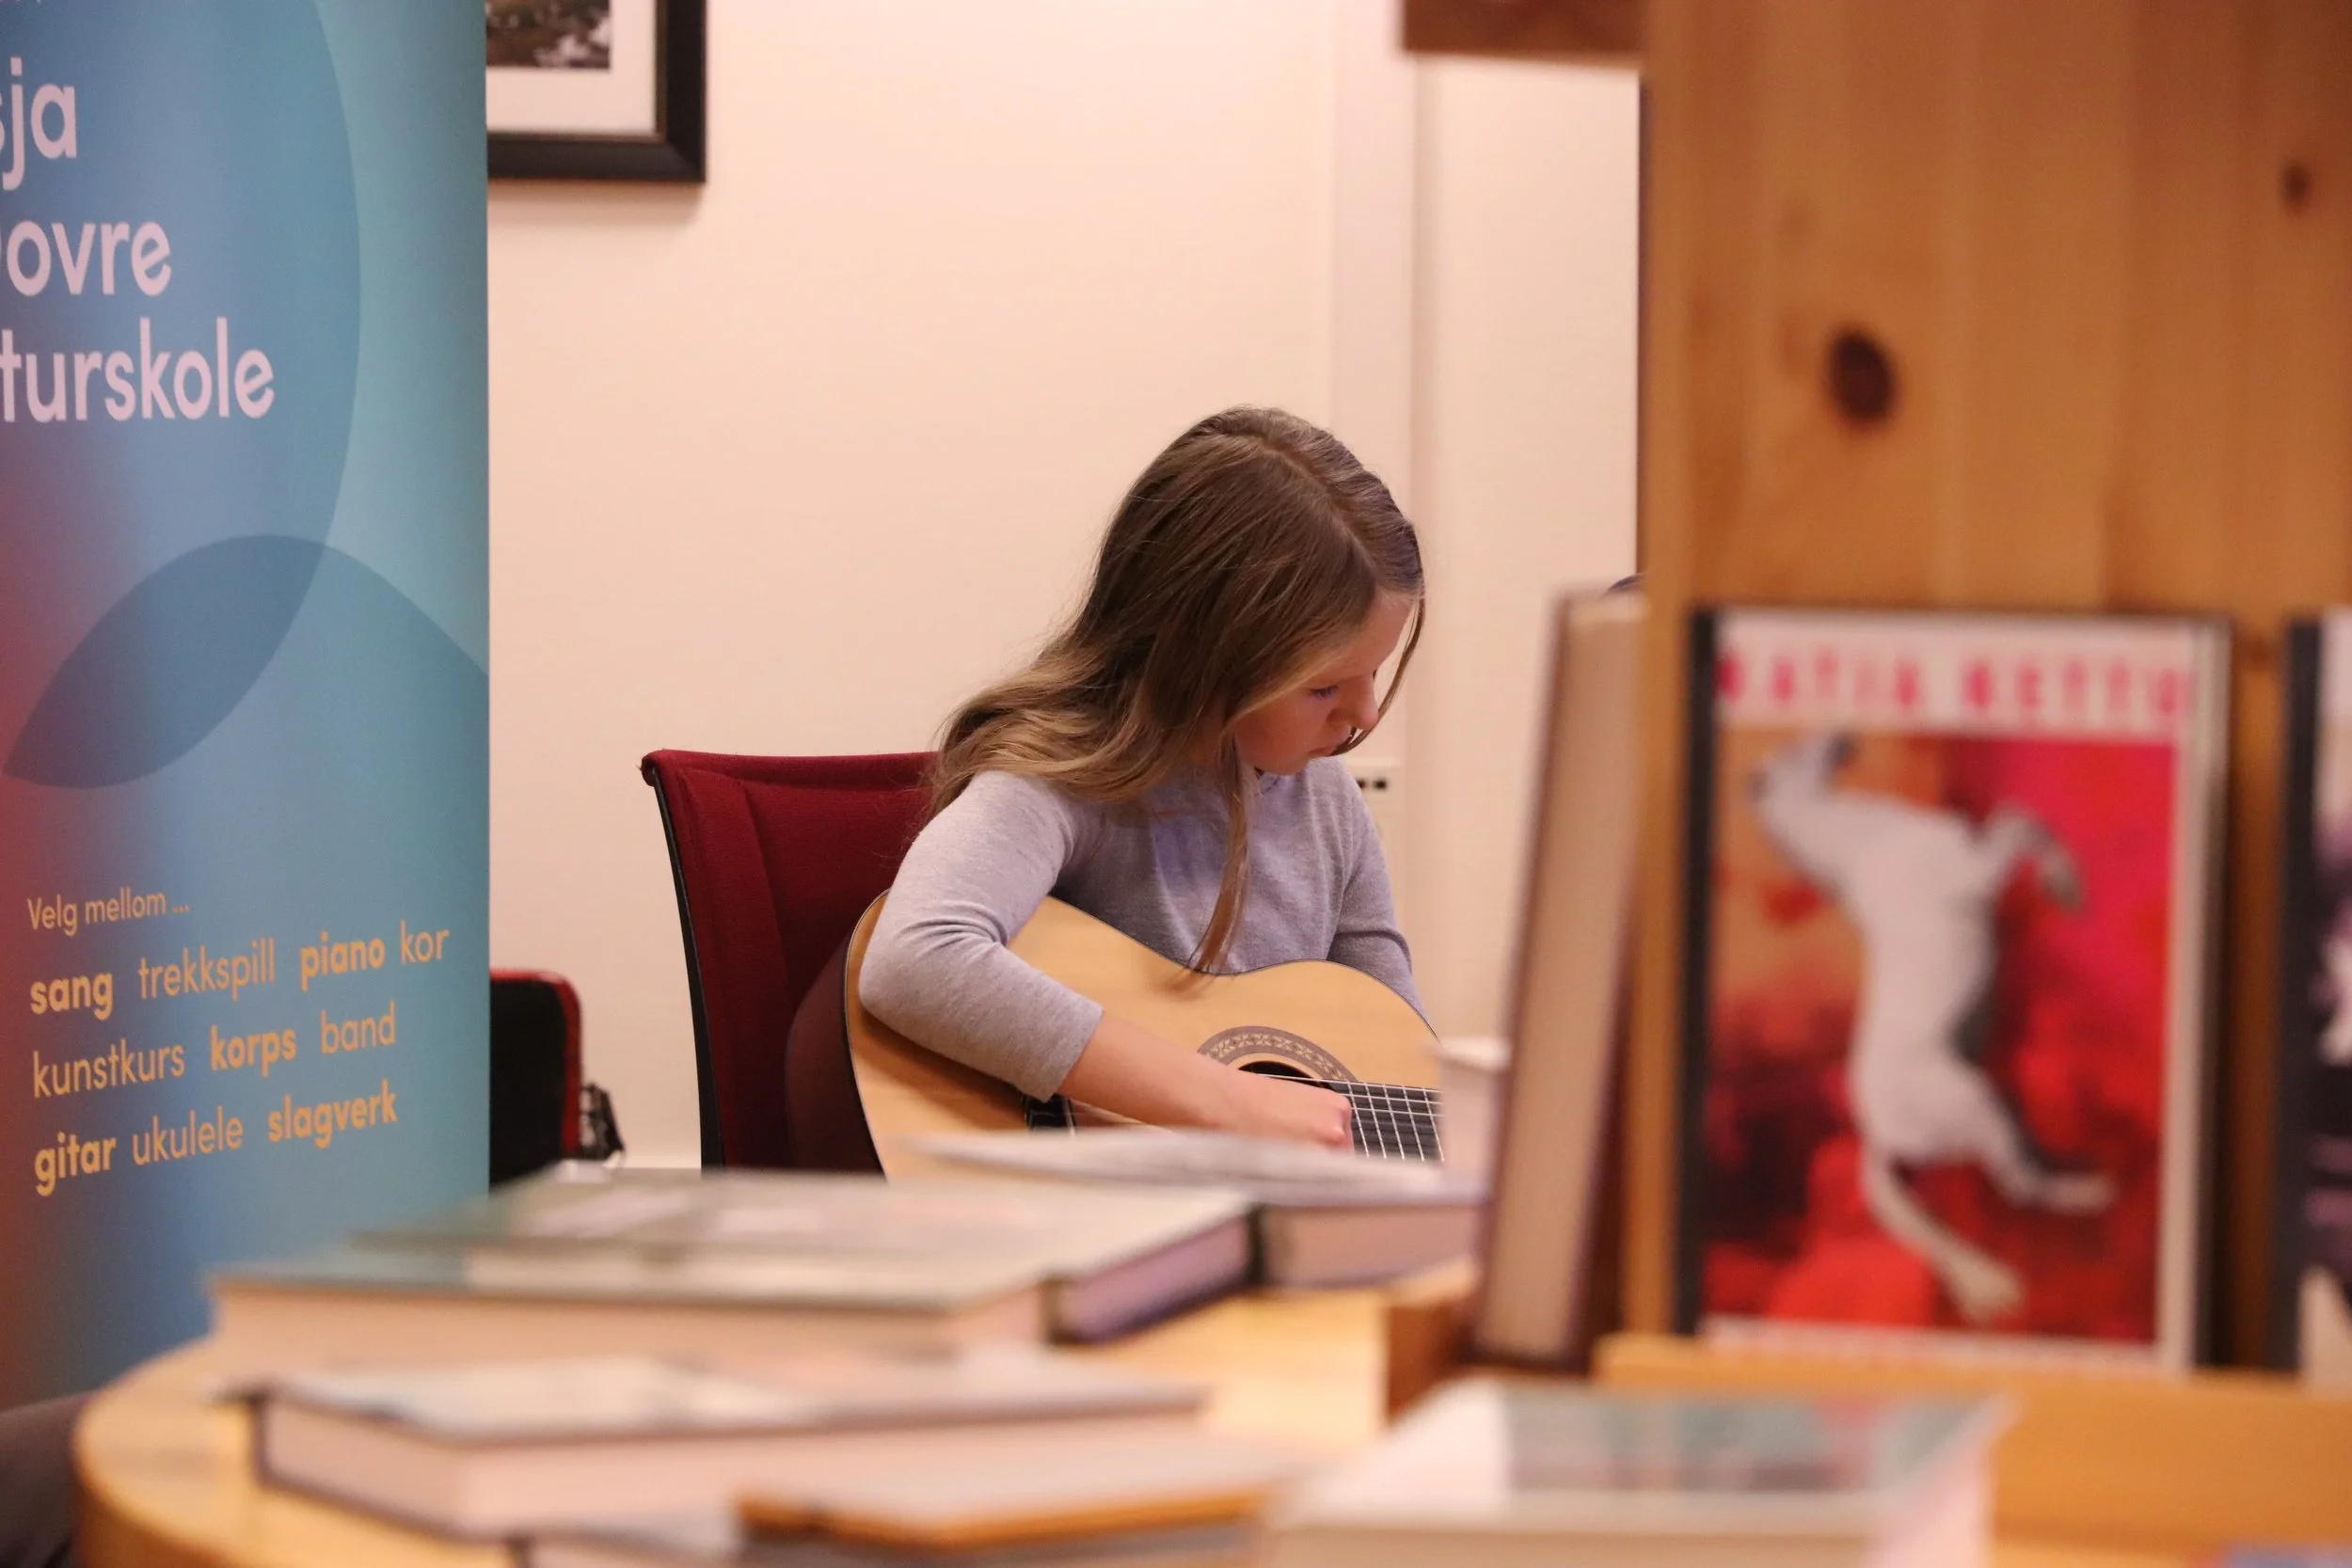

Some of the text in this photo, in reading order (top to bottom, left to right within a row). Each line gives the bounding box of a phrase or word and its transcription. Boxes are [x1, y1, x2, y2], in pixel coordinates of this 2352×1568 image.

[0, 56, 78, 190] ja
[27, 895, 78, 937] Velg
[85, 887, 167, 926] mellom
[30, 920, 451, 1021] sang trekkspill piano kor
[33, 1000, 396, 1099] kunstkurs korps band
[35, 1079, 399, 1196] gitar ukulele slagverk
